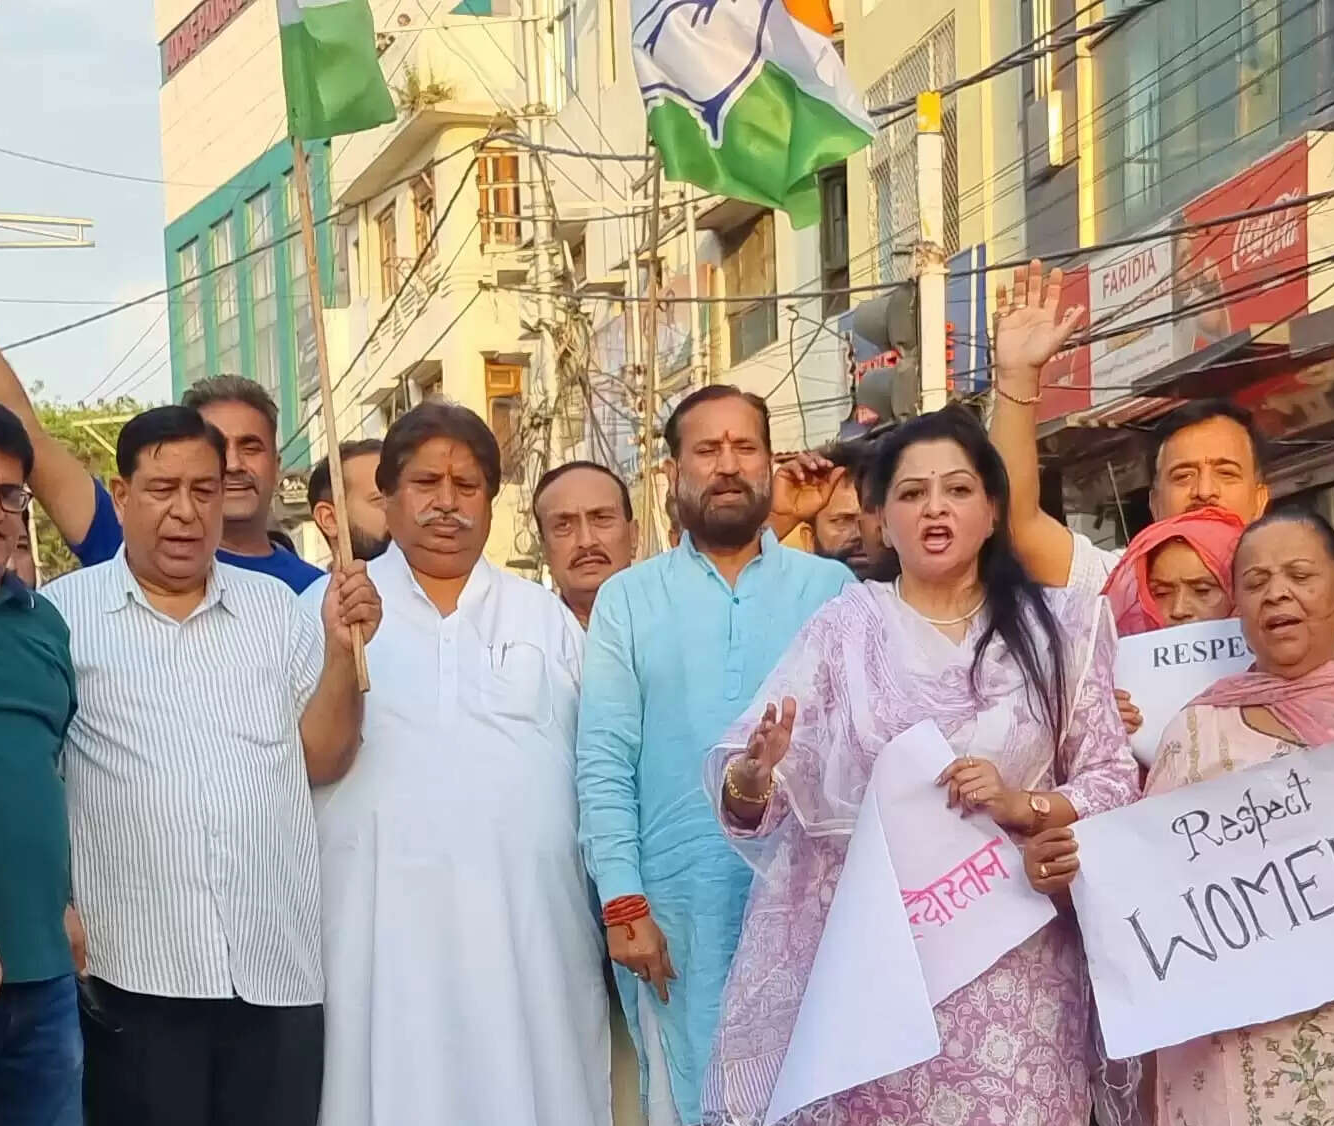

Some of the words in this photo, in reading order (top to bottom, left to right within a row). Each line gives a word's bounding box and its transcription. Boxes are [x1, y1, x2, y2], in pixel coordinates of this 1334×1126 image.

[1102, 248, 1157, 298] FARIDIA
[1153, 636, 1245, 668] RESPE
[1171, 768, 1312, 862] Respect
